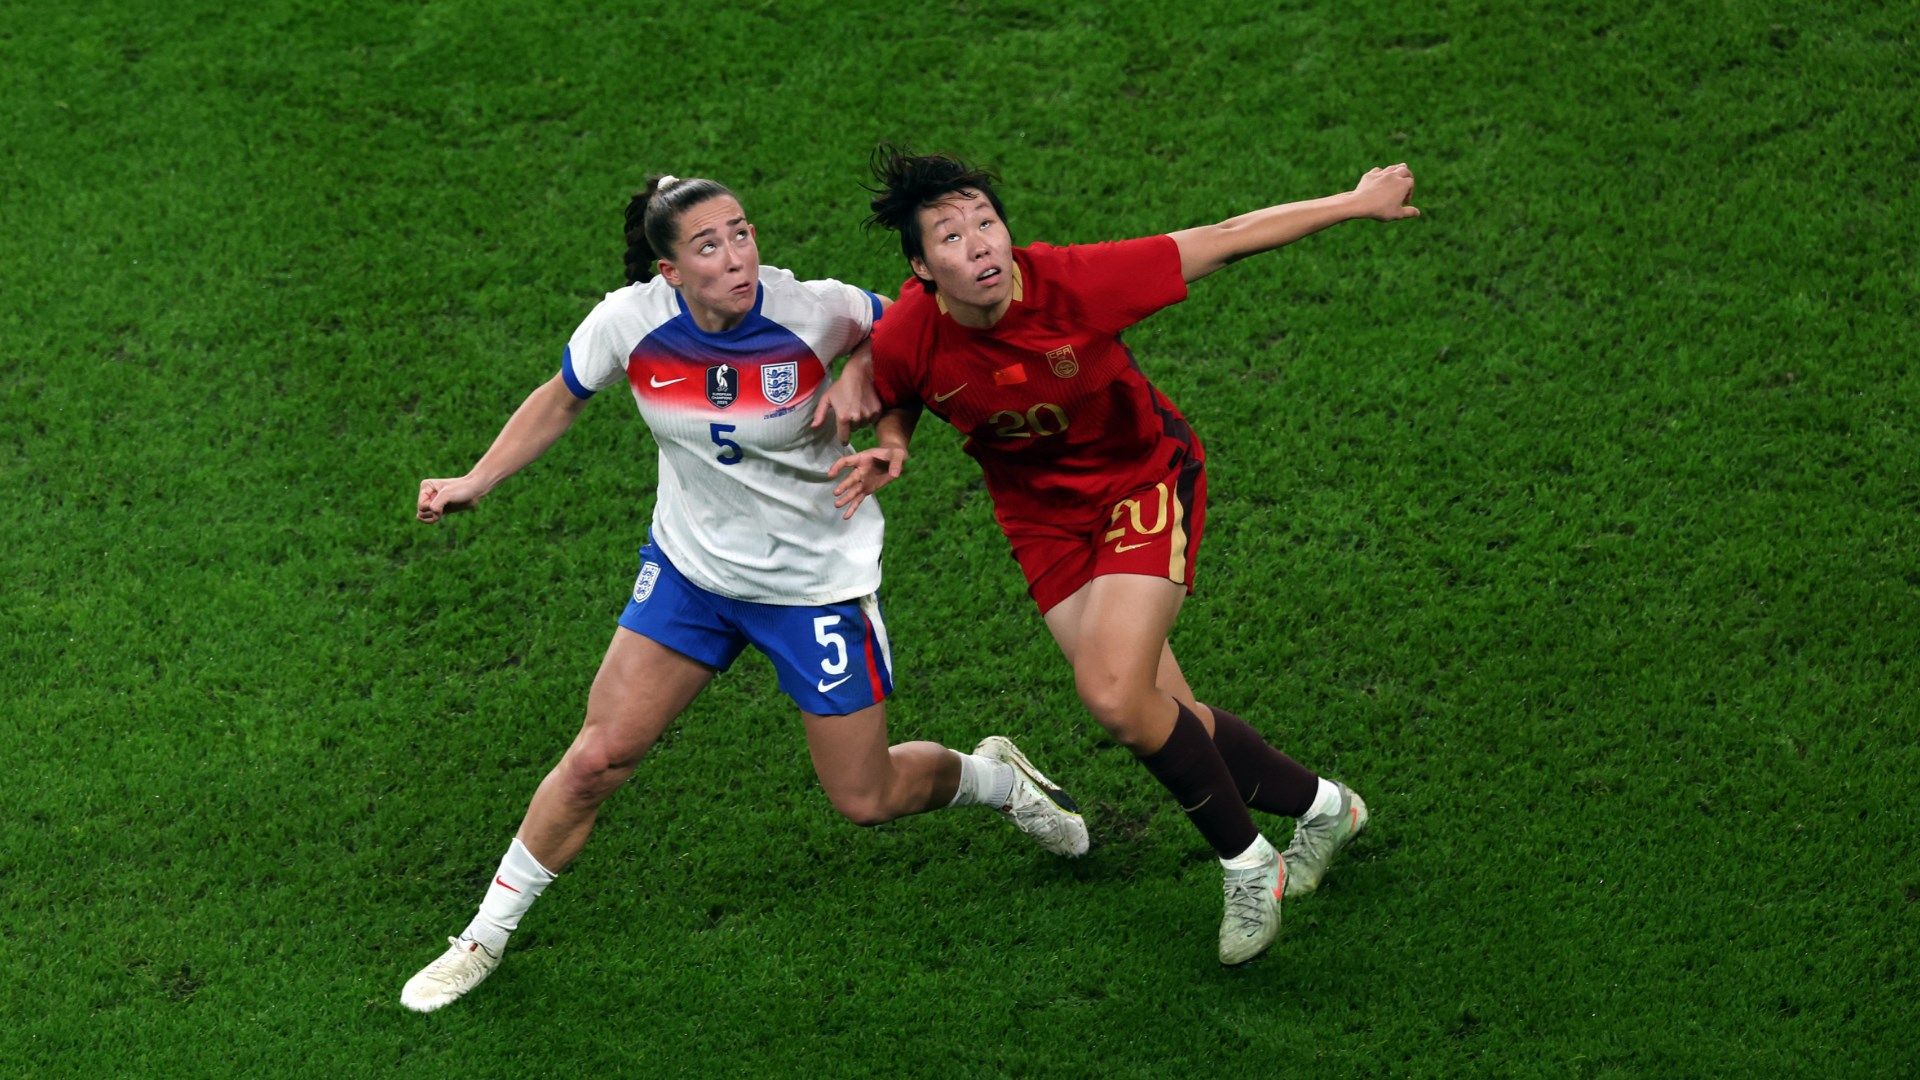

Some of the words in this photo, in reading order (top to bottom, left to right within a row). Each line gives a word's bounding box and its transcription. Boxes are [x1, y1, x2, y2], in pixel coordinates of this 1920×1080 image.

[1049, 347, 1070, 359] CFA
[988, 403, 1069, 438] 20
[709, 422, 744, 466] 5
[1104, 482, 1169, 543] 20
[813, 614, 848, 675] 5
